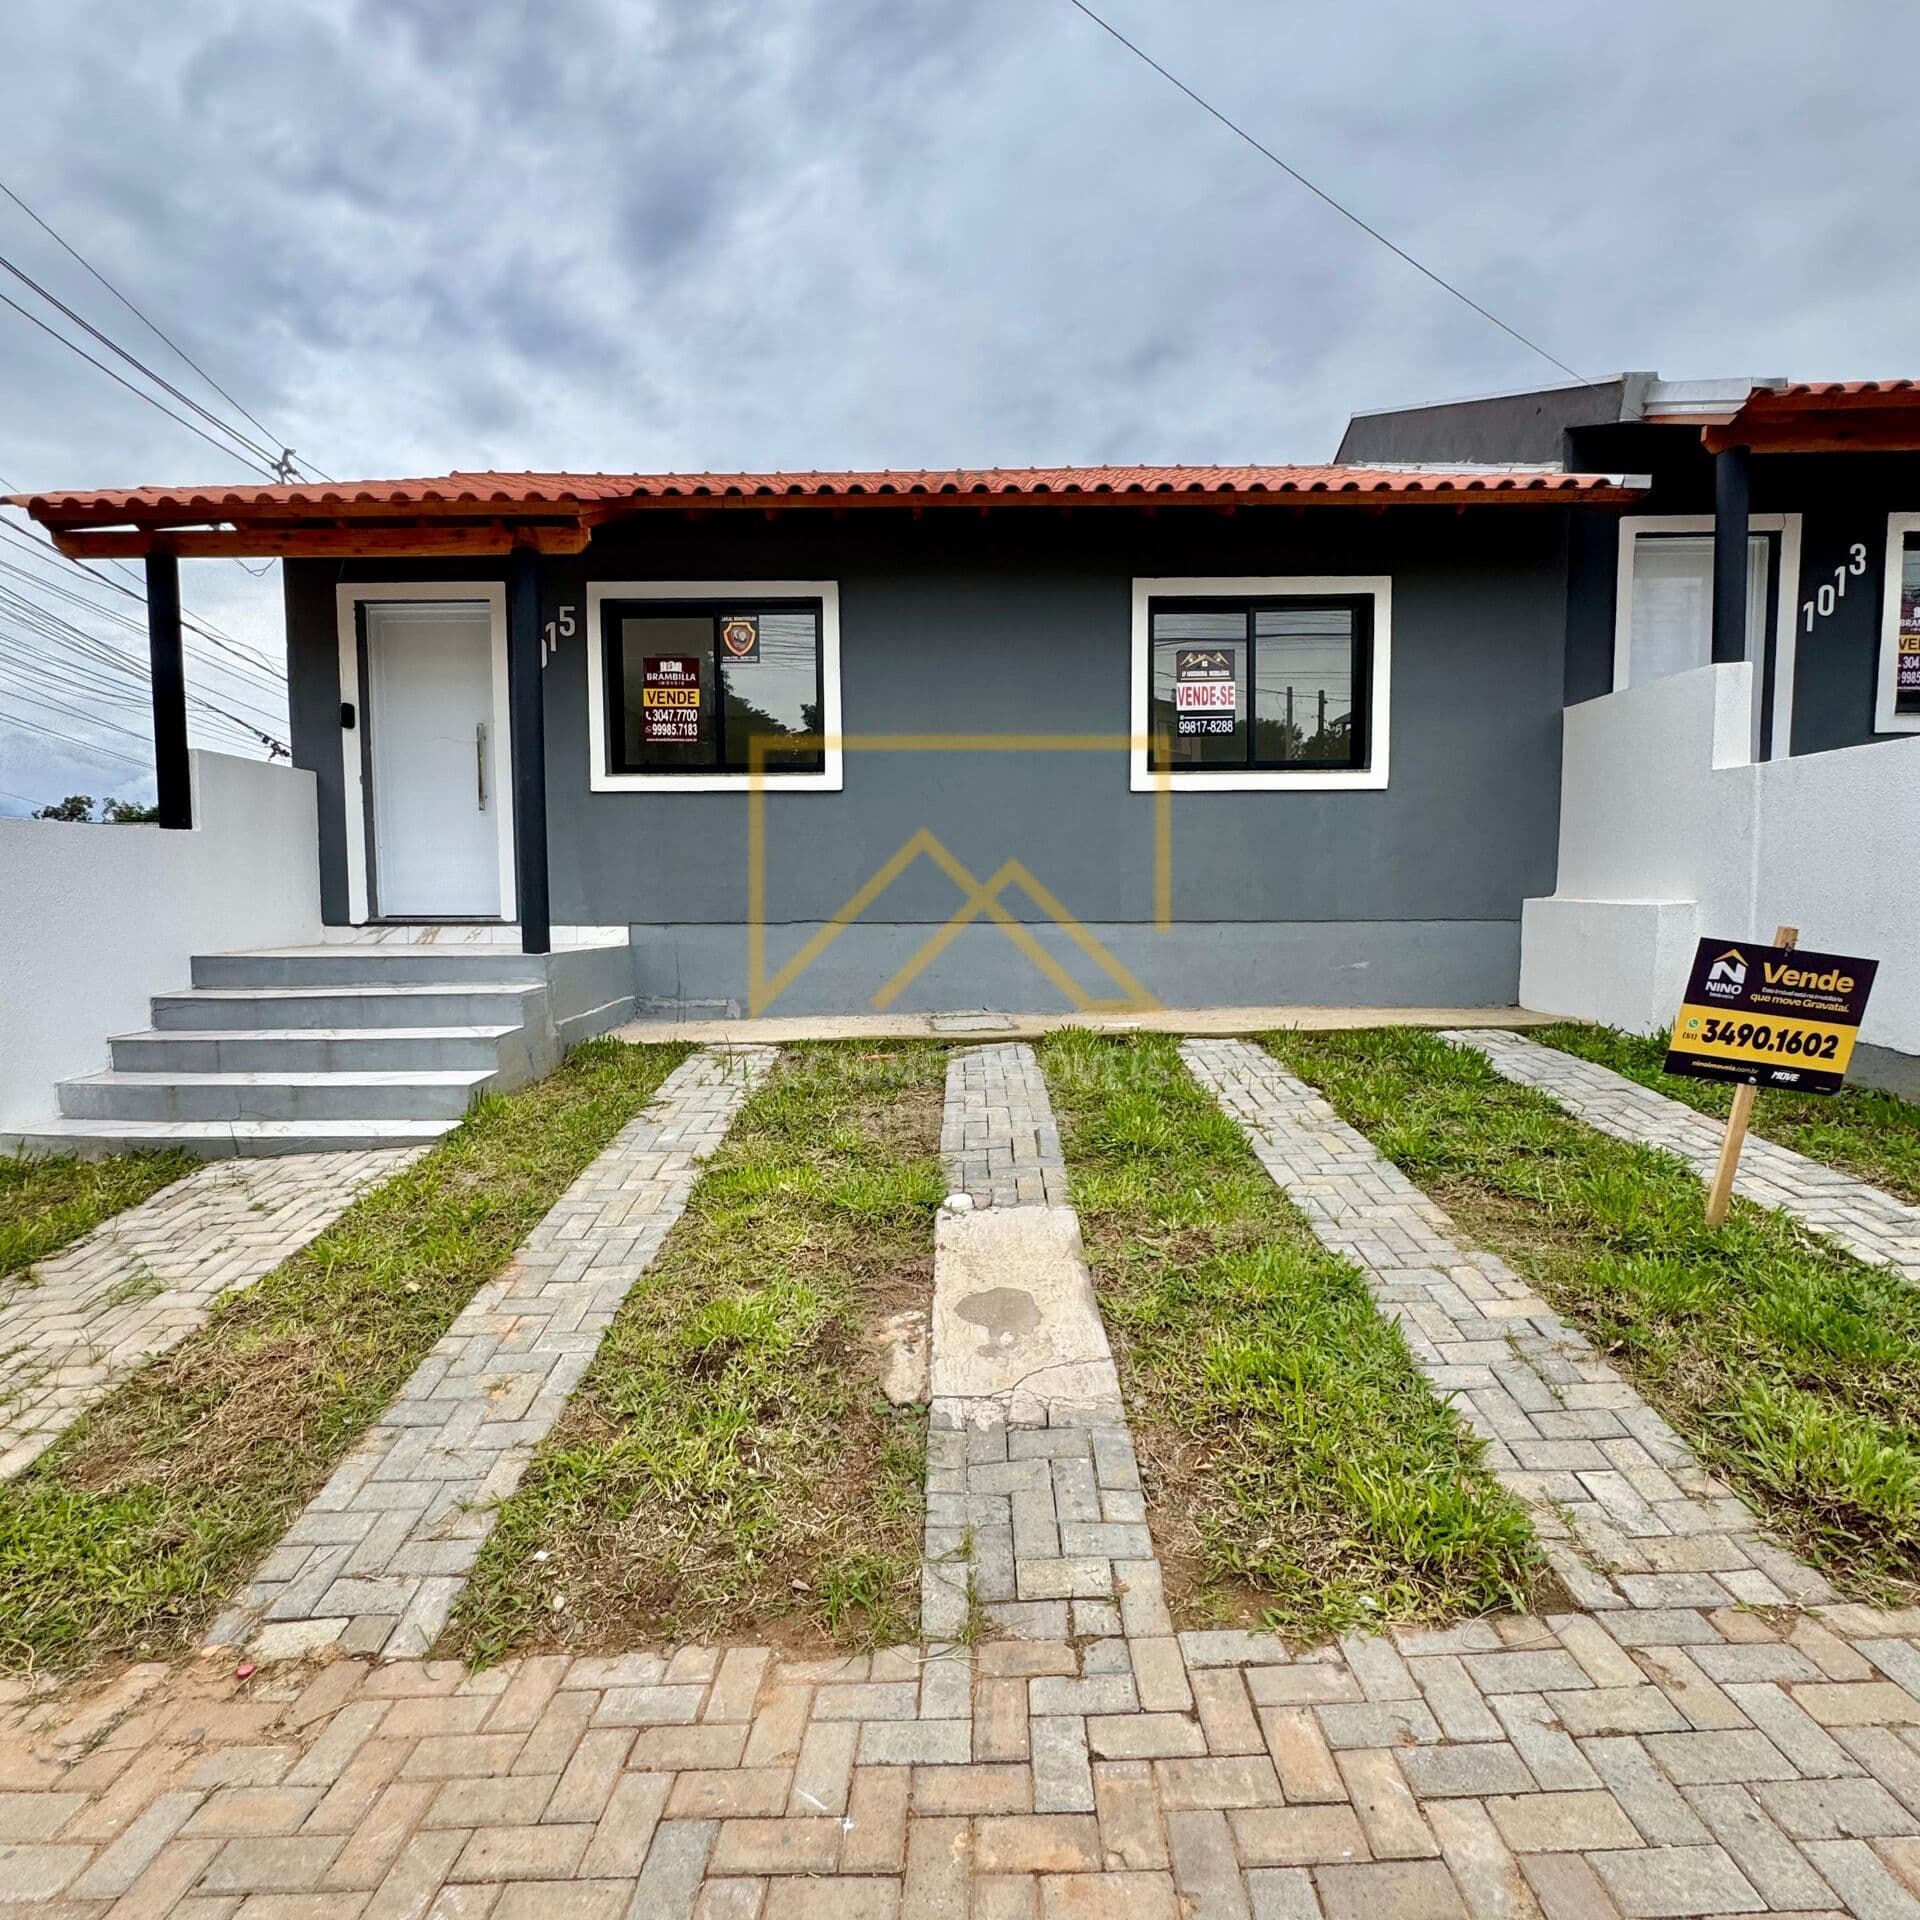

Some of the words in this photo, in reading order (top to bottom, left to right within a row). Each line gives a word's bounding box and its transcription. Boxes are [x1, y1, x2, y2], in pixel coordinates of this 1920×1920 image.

[1803, 543, 1866, 632] 1013
[646, 672, 696, 681] BRAMBILLA
[646, 690, 697, 705] VENDE
[1178, 685, 1234, 706] VENDE-SE
[652, 709, 698, 722] 3047.7700
[652, 723, 698, 736] 99985.7183
[1178, 720, 1233, 734] 99817-8288
[1763, 961, 1855, 993] Vende
[1705, 981, 1742, 995] NINO
[1750, 993, 1772, 1003] que
[1772, 995, 1802, 1006] move
[1701, 1018, 1839, 1060] 3490.1602
